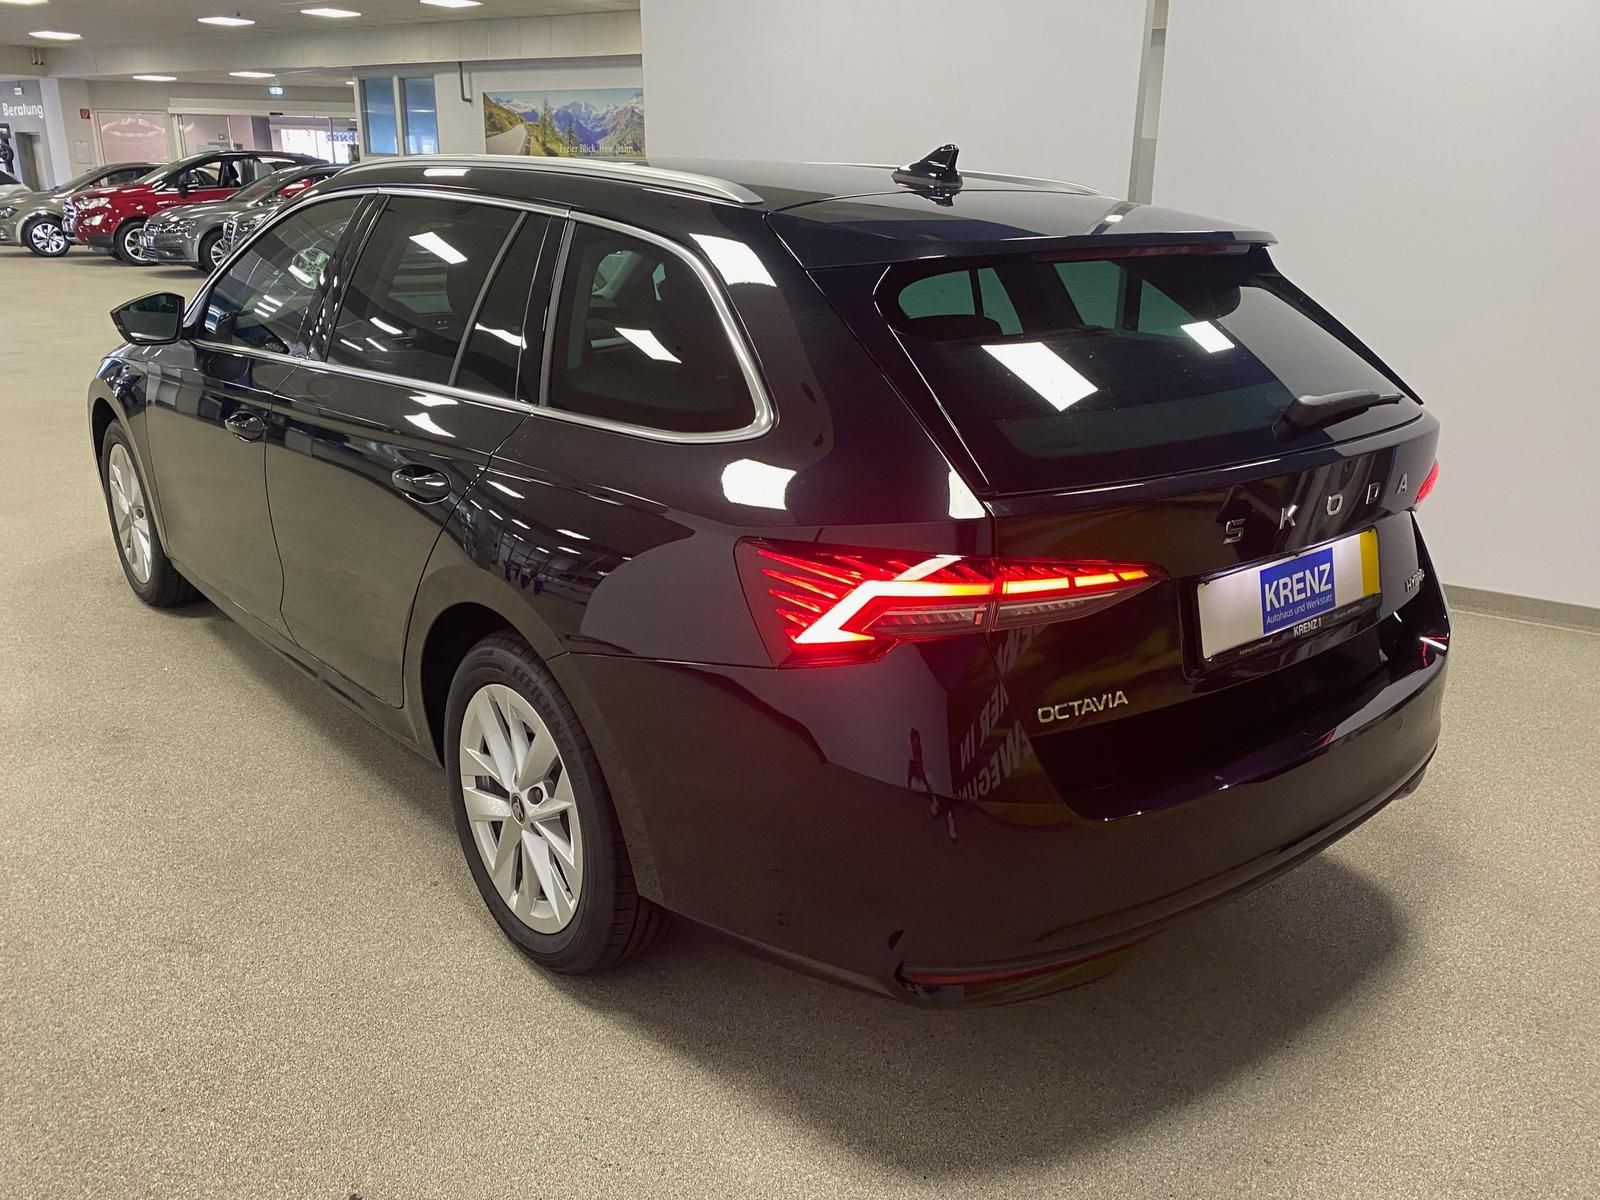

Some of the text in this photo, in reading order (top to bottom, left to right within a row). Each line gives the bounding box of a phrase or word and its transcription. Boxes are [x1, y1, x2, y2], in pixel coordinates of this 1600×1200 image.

[2, 102, 44, 119] Beratung
[1264, 562, 1332, 612] KRENZ
[1266, 593, 1333, 625] Autohaus und Werkstatt
[1293, 618, 1319, 637] KRENZ
[1037, 690, 1129, 724] OCTAVIA
